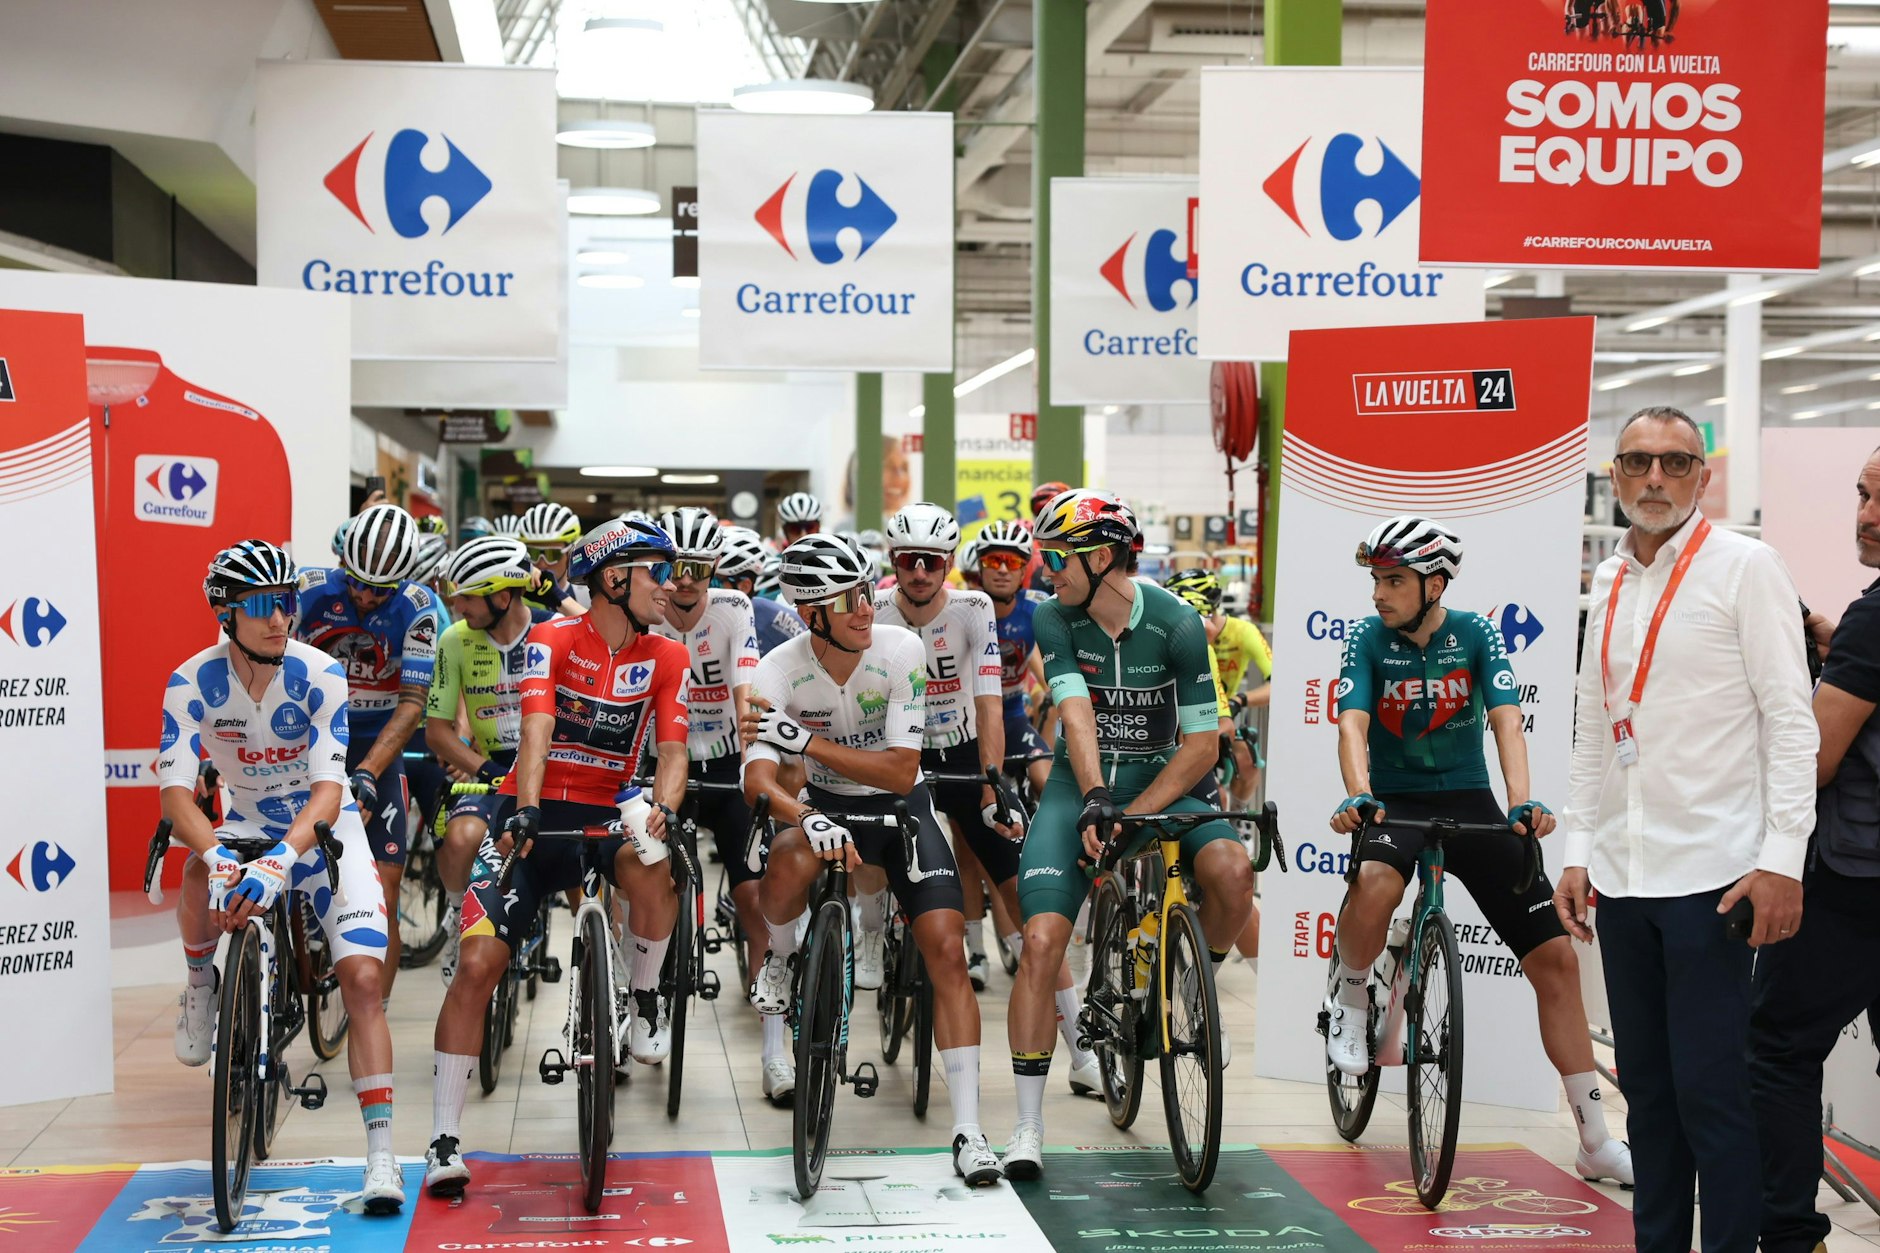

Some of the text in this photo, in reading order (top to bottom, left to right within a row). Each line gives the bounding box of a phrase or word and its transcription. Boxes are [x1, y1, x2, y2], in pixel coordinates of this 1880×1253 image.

[1528, 51, 1720, 74] CARREFOUR CON LA VUELTA
[1504, 79, 1742, 132] SOMOS
[1498, 135, 1743, 188] EQUIPO
[1523, 235, 1713, 252] #CARREFOURCONLAVUELTA
[302, 259, 514, 297] Carrefour
[1241, 262, 1444, 297] Carrefour
[736, 283, 916, 316] Carrefour
[1364, 376, 1507, 407] LA VUELTA 24
[142, 502, 208, 520] Carrefour
[1418, 539, 1443, 557] GIANT
[503, 570, 525, 579] uvex
[796, 587, 828, 595] RUDY
[1383, 658, 1412, 666] GIANT
[34, 677, 69, 697] SUR.
[1383, 677, 1470, 701] KERN
[1104, 690, 1166, 707] VISMA
[1304, 678, 1321, 725] ETAPA
[1383, 700, 1470, 711] PHARMA
[595, 711, 635, 727] BORA
[800, 709, 833, 719] Santini
[213, 718, 248, 729] Santini
[1023, 866, 1065, 881] Santini
[336, 909, 374, 926] Santini
[42, 920, 78, 942] SUR.
[1293, 911, 1336, 960] ETAPA 6
[437, 1239, 610, 1251] Carrefour
[845, 1232, 1008, 1243] plenitude
